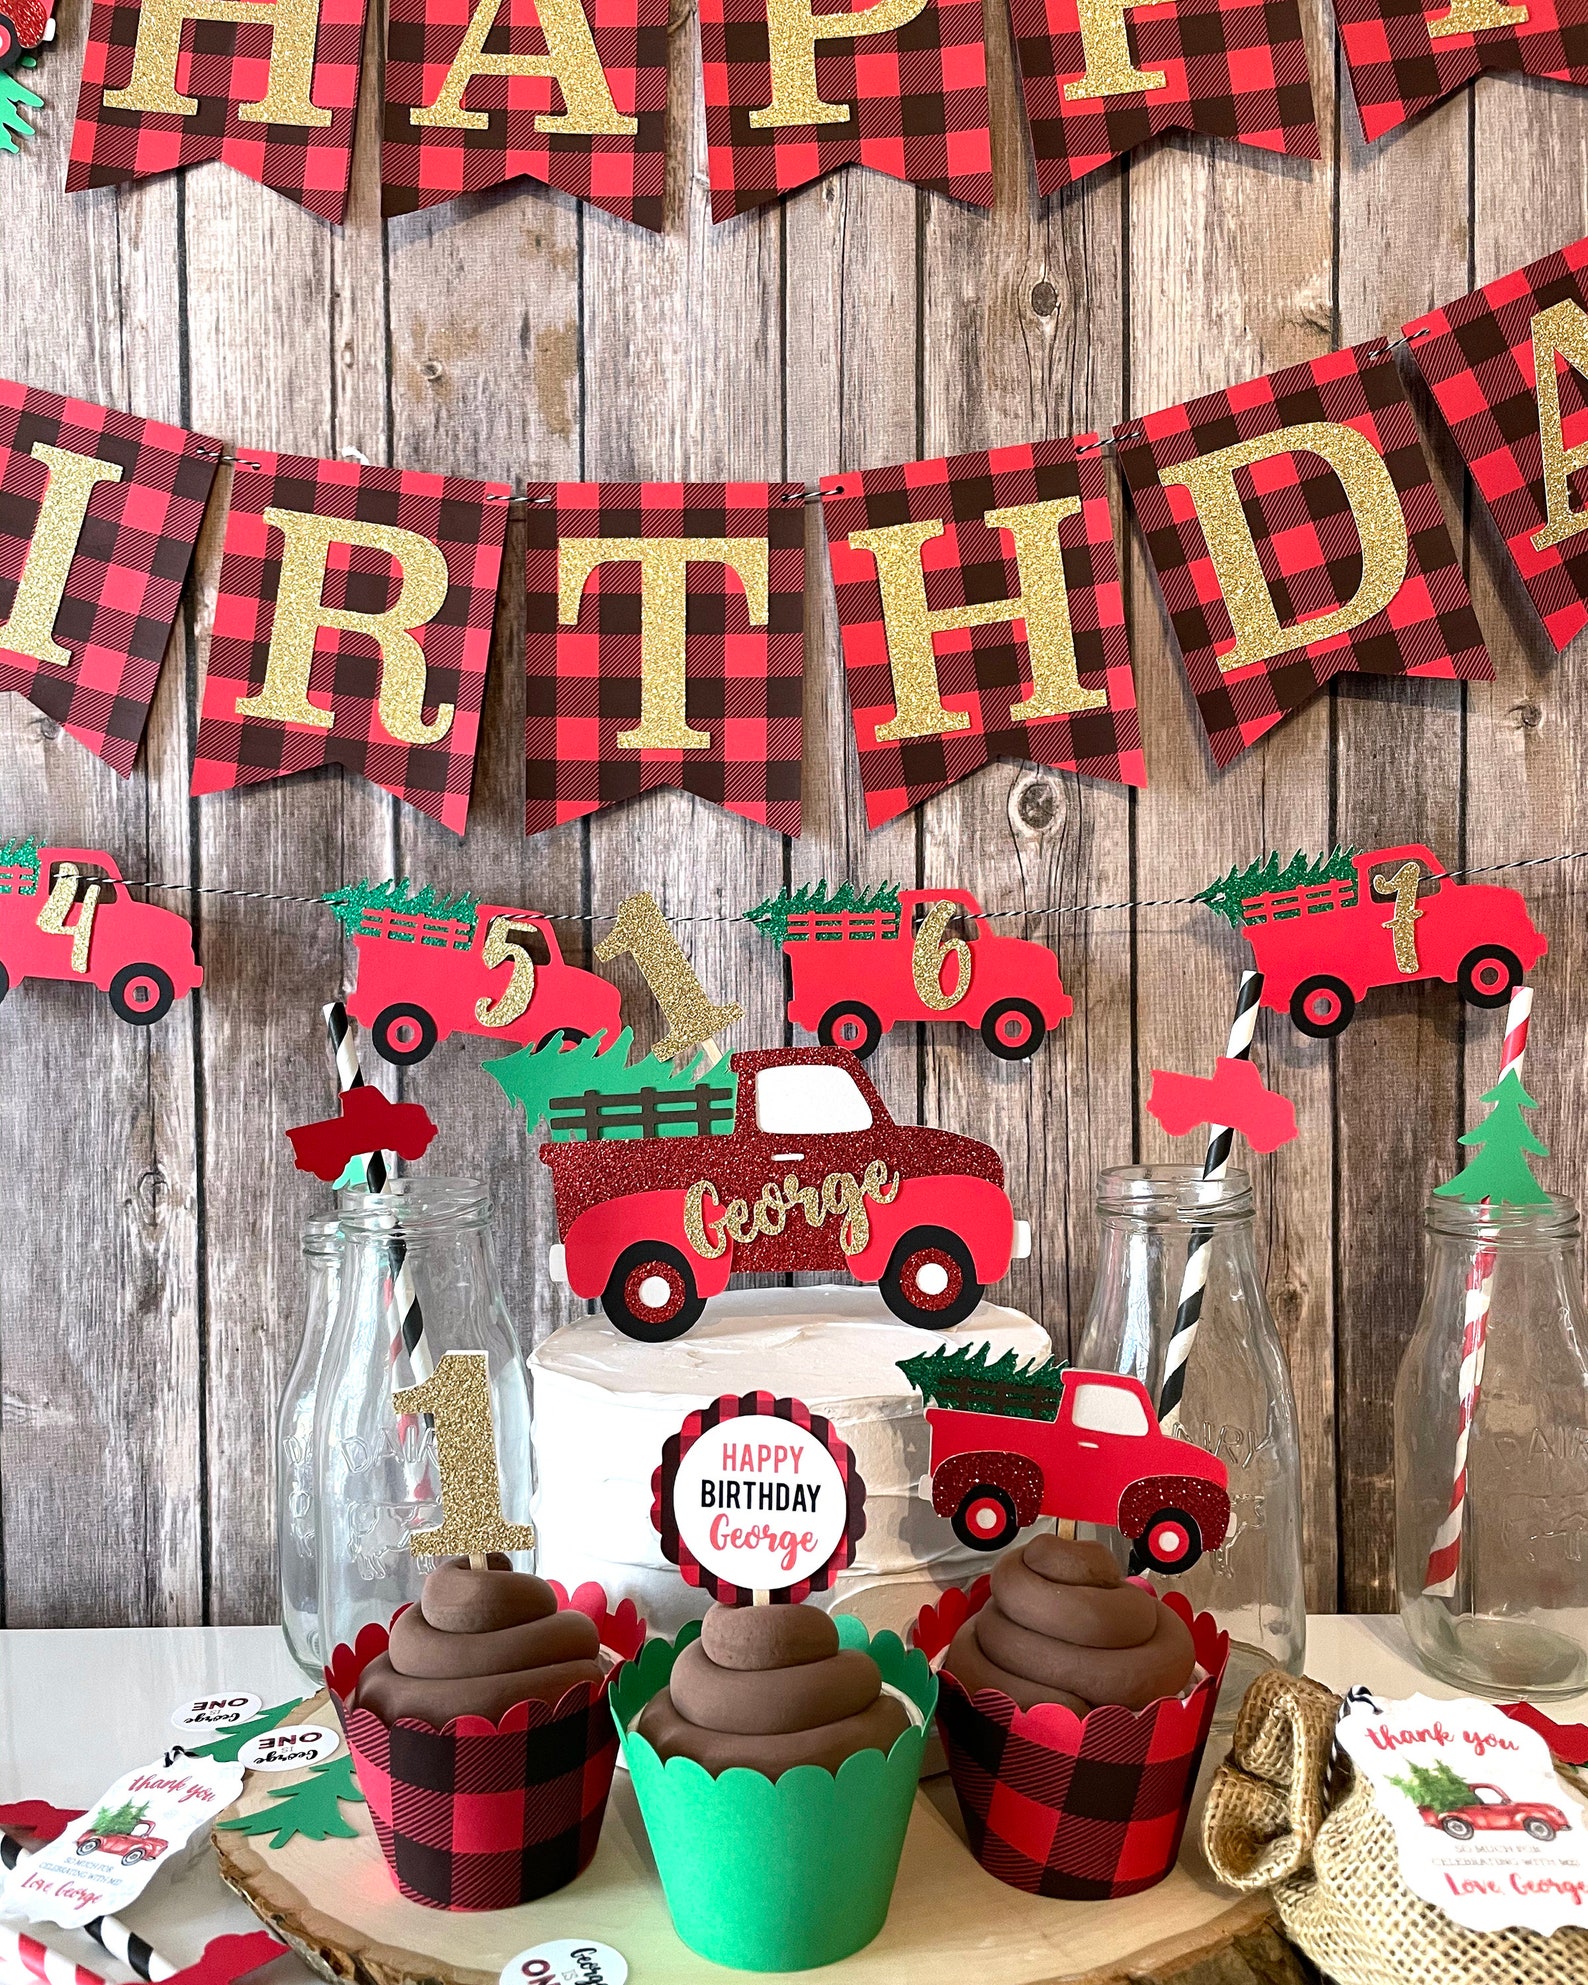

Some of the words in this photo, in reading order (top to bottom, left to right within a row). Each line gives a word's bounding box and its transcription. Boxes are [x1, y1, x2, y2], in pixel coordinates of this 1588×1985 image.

[36, 862, 100, 974] 4
[1373, 861, 1425, 974] 7
[475, 917, 537, 1028] 5
[911, 900, 973, 1011] 6
[594, 891, 745, 1064] 1
[684, 1160, 899, 1259] George
[391, 1351, 536, 1558] 1
[722, 1443, 804, 1474] HAPPY
[701, 1479, 821, 1513] BIRTHDAY
[709, 1513, 818, 1571] George
[184, 1712, 240, 1724] George
[192, 1698, 249, 1712] ONE
[254, 1749, 318, 1764] George
[258, 1732, 322, 1750] ONE
[1365, 1721, 1455, 1750] thank
[1463, 1730, 1519, 1756] you
[128, 1774, 193, 1793] thank
[178, 1784, 216, 1803] you
[21, 1872, 54, 1893] Love
[54, 1880, 103, 1910] George
[1444, 1872, 1505, 1895] Love
[570, 1947, 609, 1985] Georg
